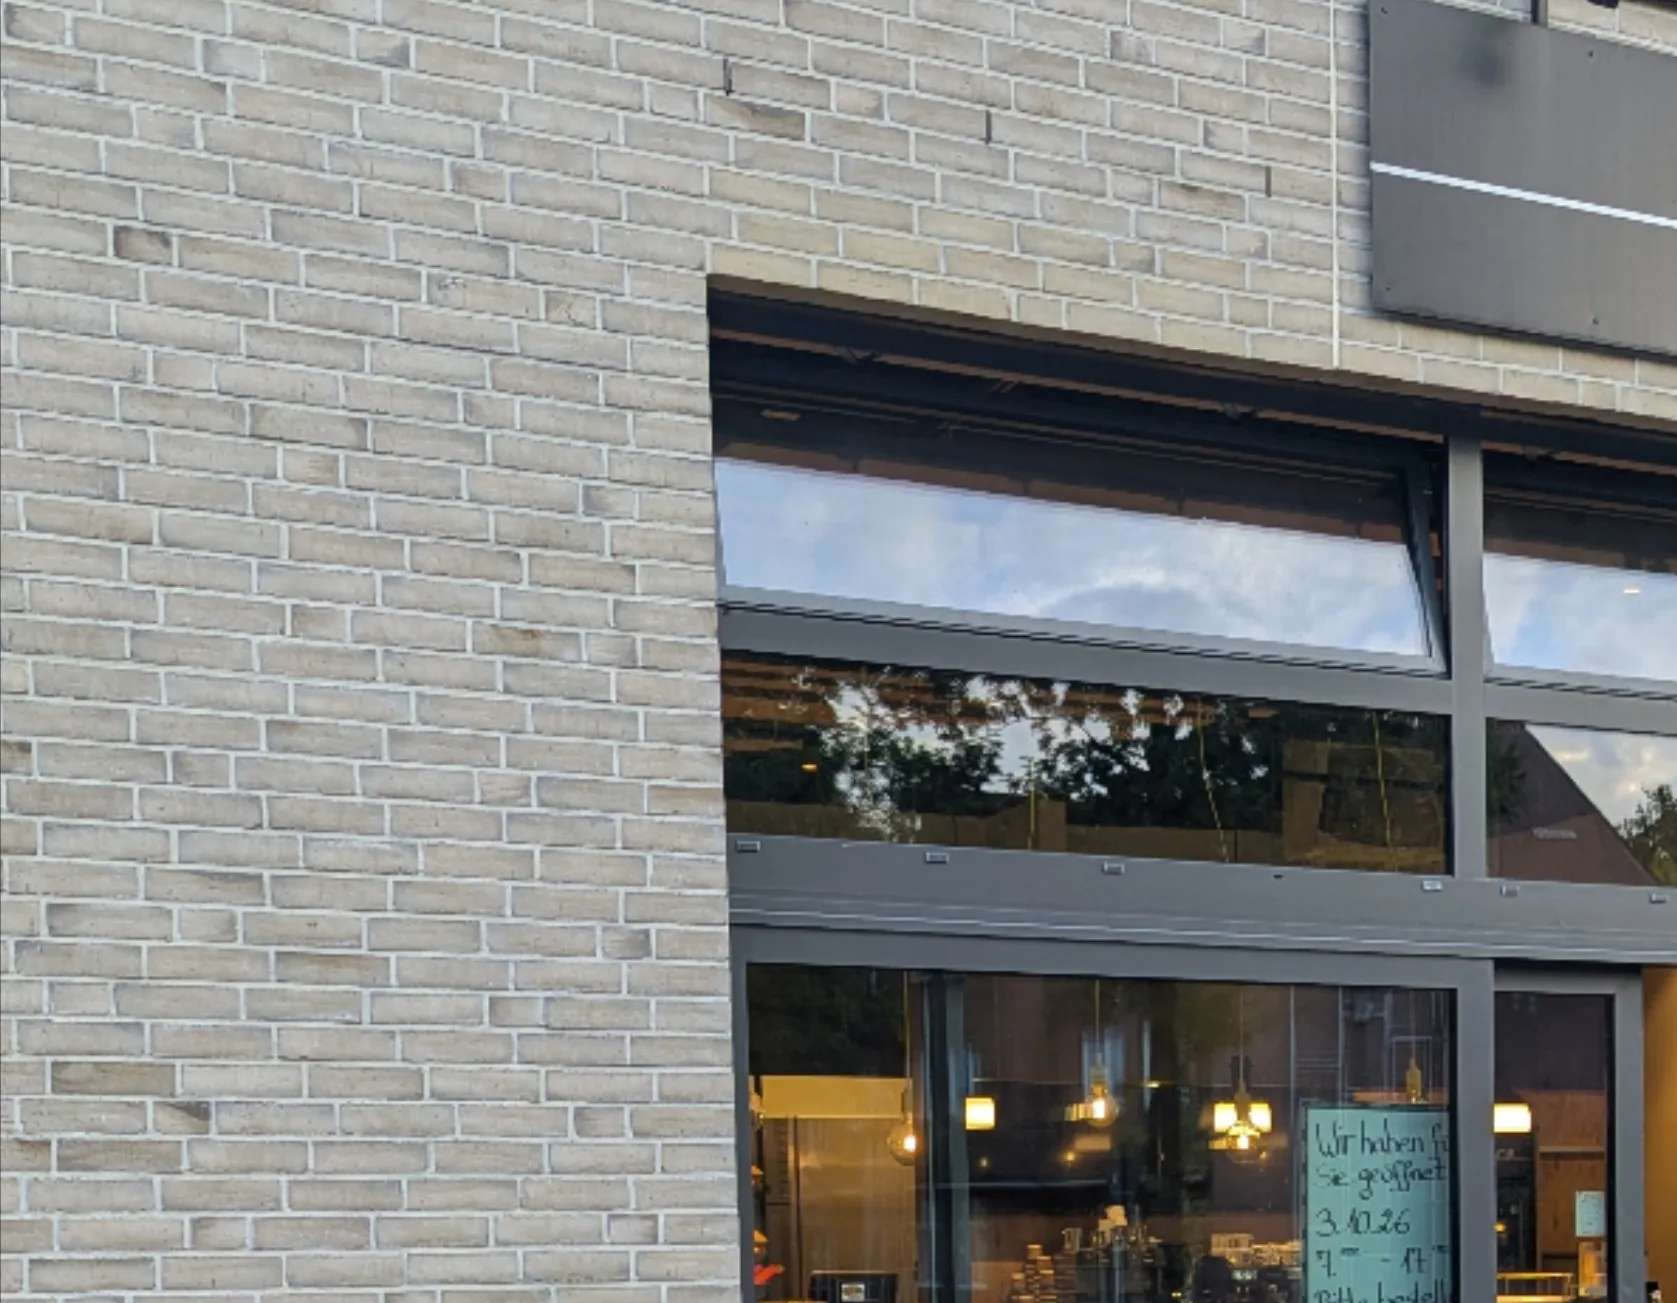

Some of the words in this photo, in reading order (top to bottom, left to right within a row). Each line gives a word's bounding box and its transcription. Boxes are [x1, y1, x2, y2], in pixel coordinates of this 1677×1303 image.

[1315, 1120, 1357, 1158] Wir
[1361, 1117, 1425, 1156] haben
[1314, 1162, 1351, 1188] Sie
[1358, 1156, 1448, 1200] geöffnet
